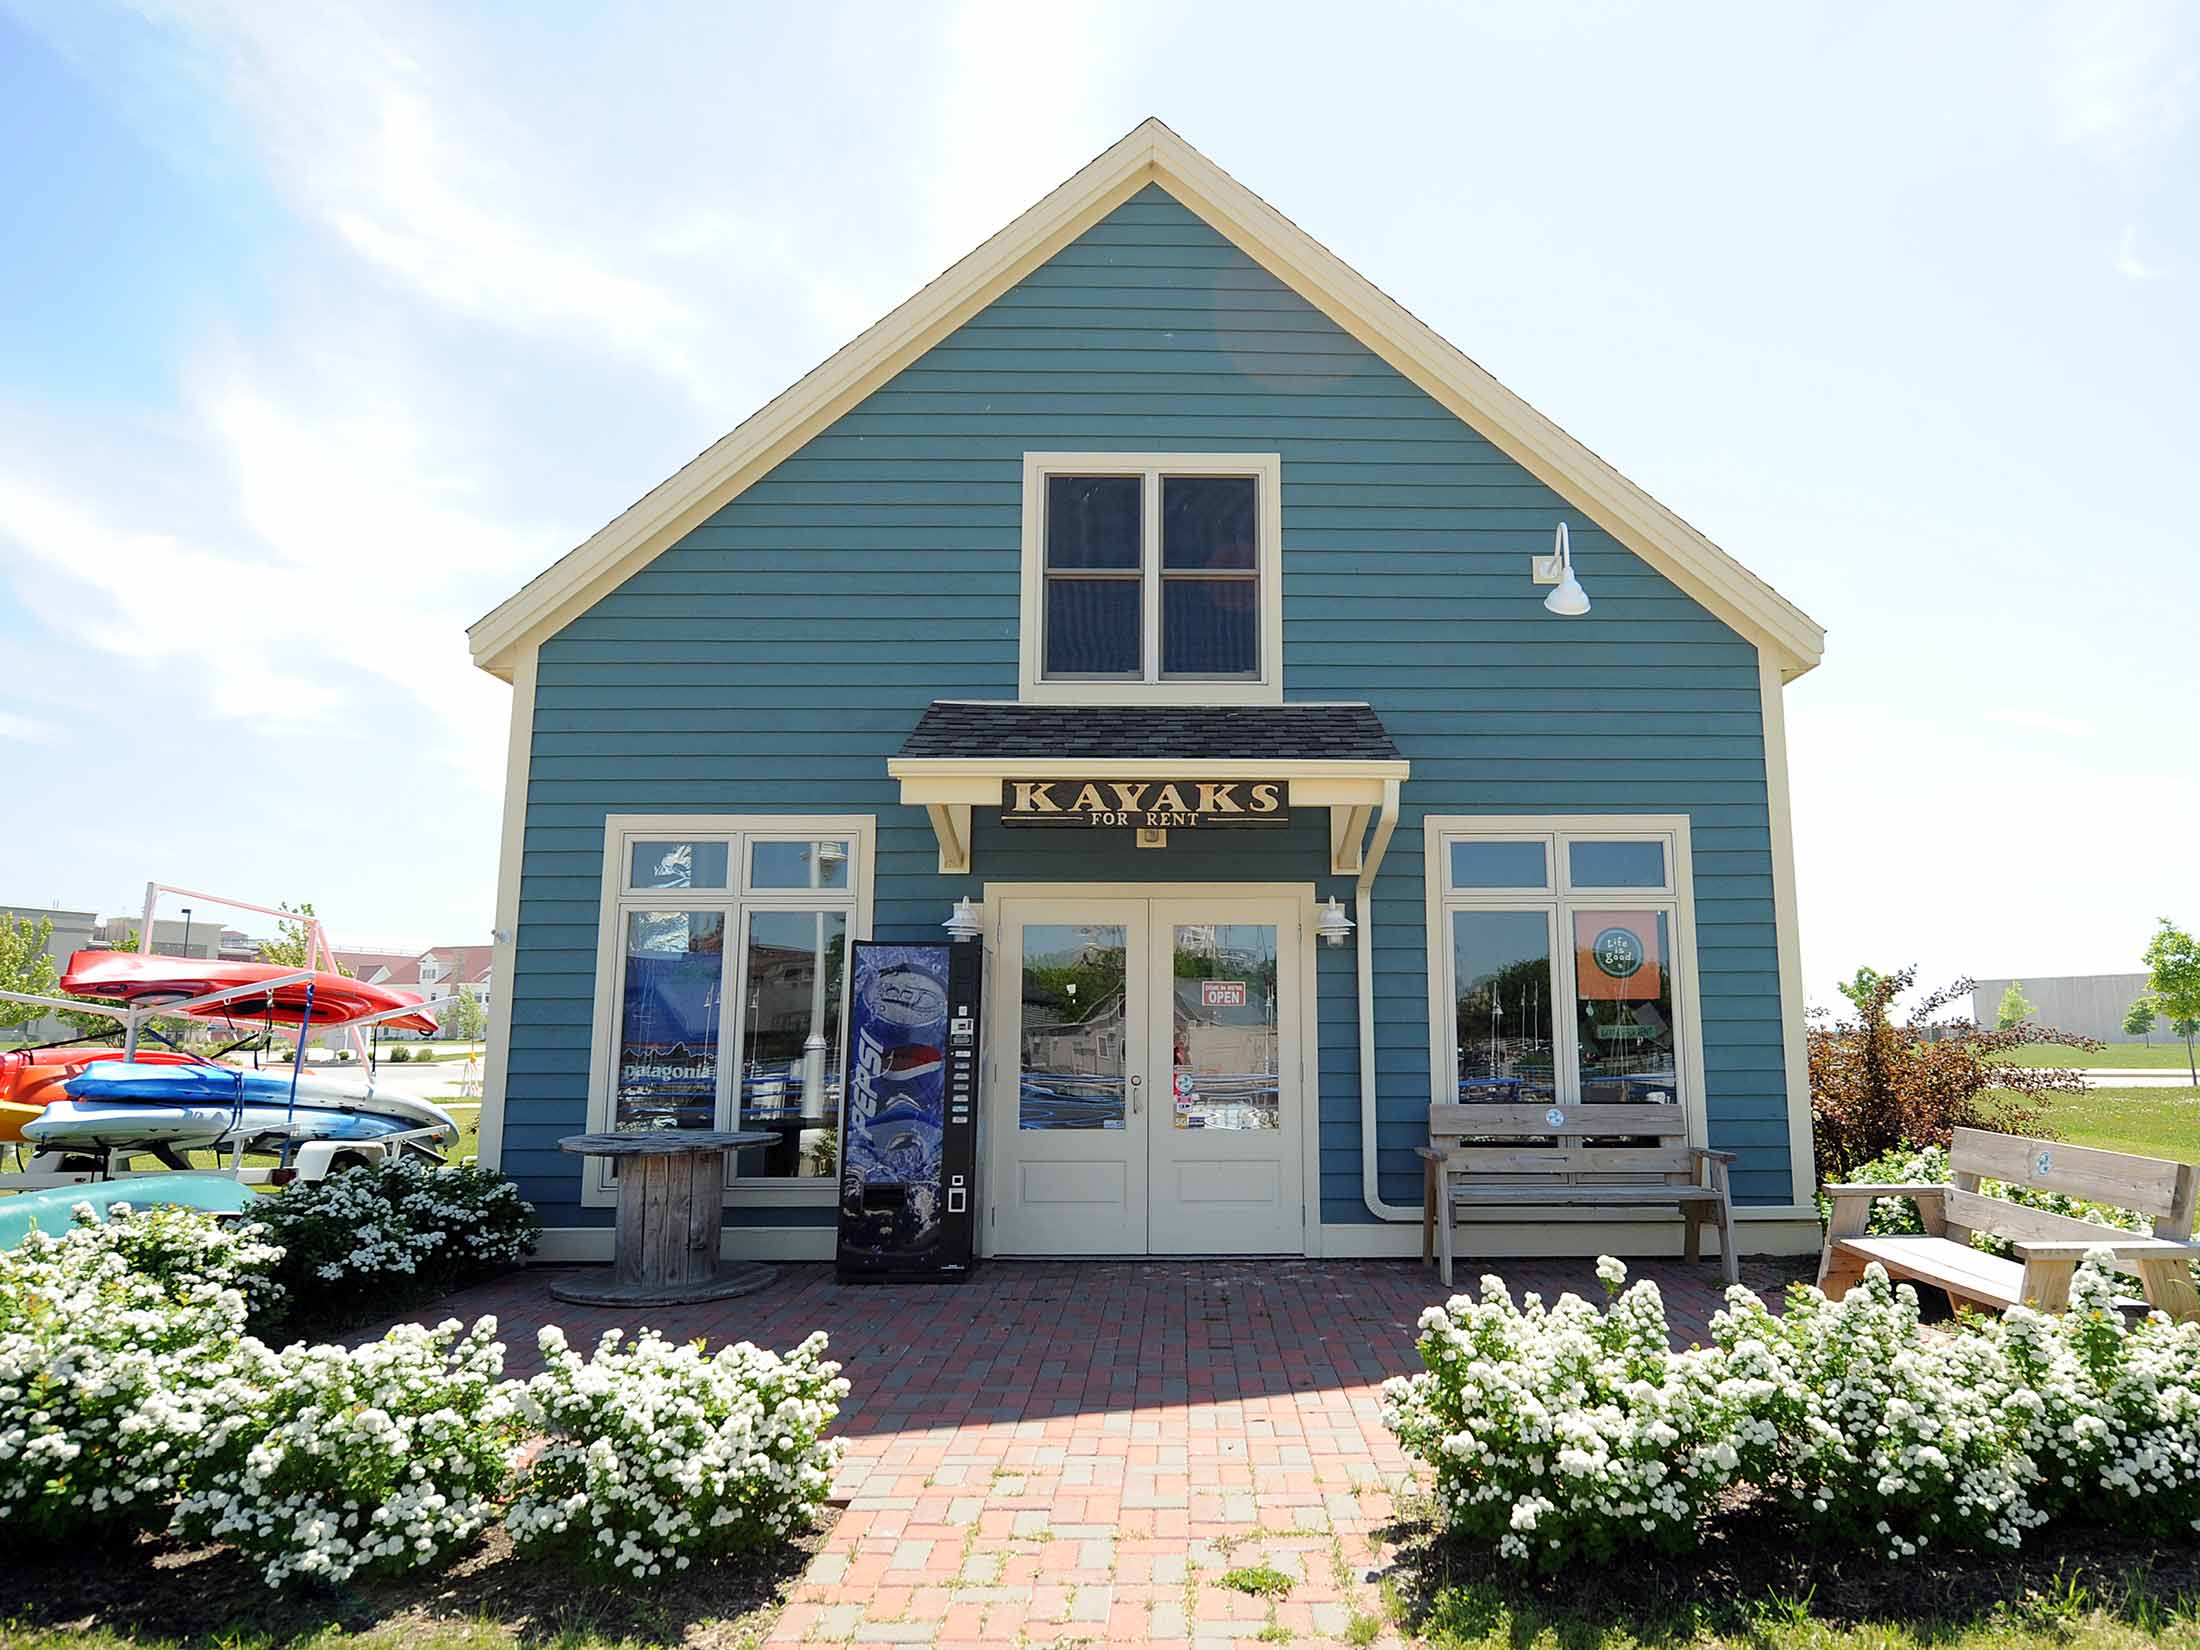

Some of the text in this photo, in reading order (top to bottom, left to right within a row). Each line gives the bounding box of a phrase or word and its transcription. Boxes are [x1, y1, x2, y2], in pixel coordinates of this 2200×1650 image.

[1012, 782, 1280, 812] KAYAKS
[1091, 813, 1199, 826] FOR RENT
[1607, 936, 1628, 948] Life
[1208, 991, 1239, 1004] OPEN
[851, 1026, 884, 1141] PEPSI
